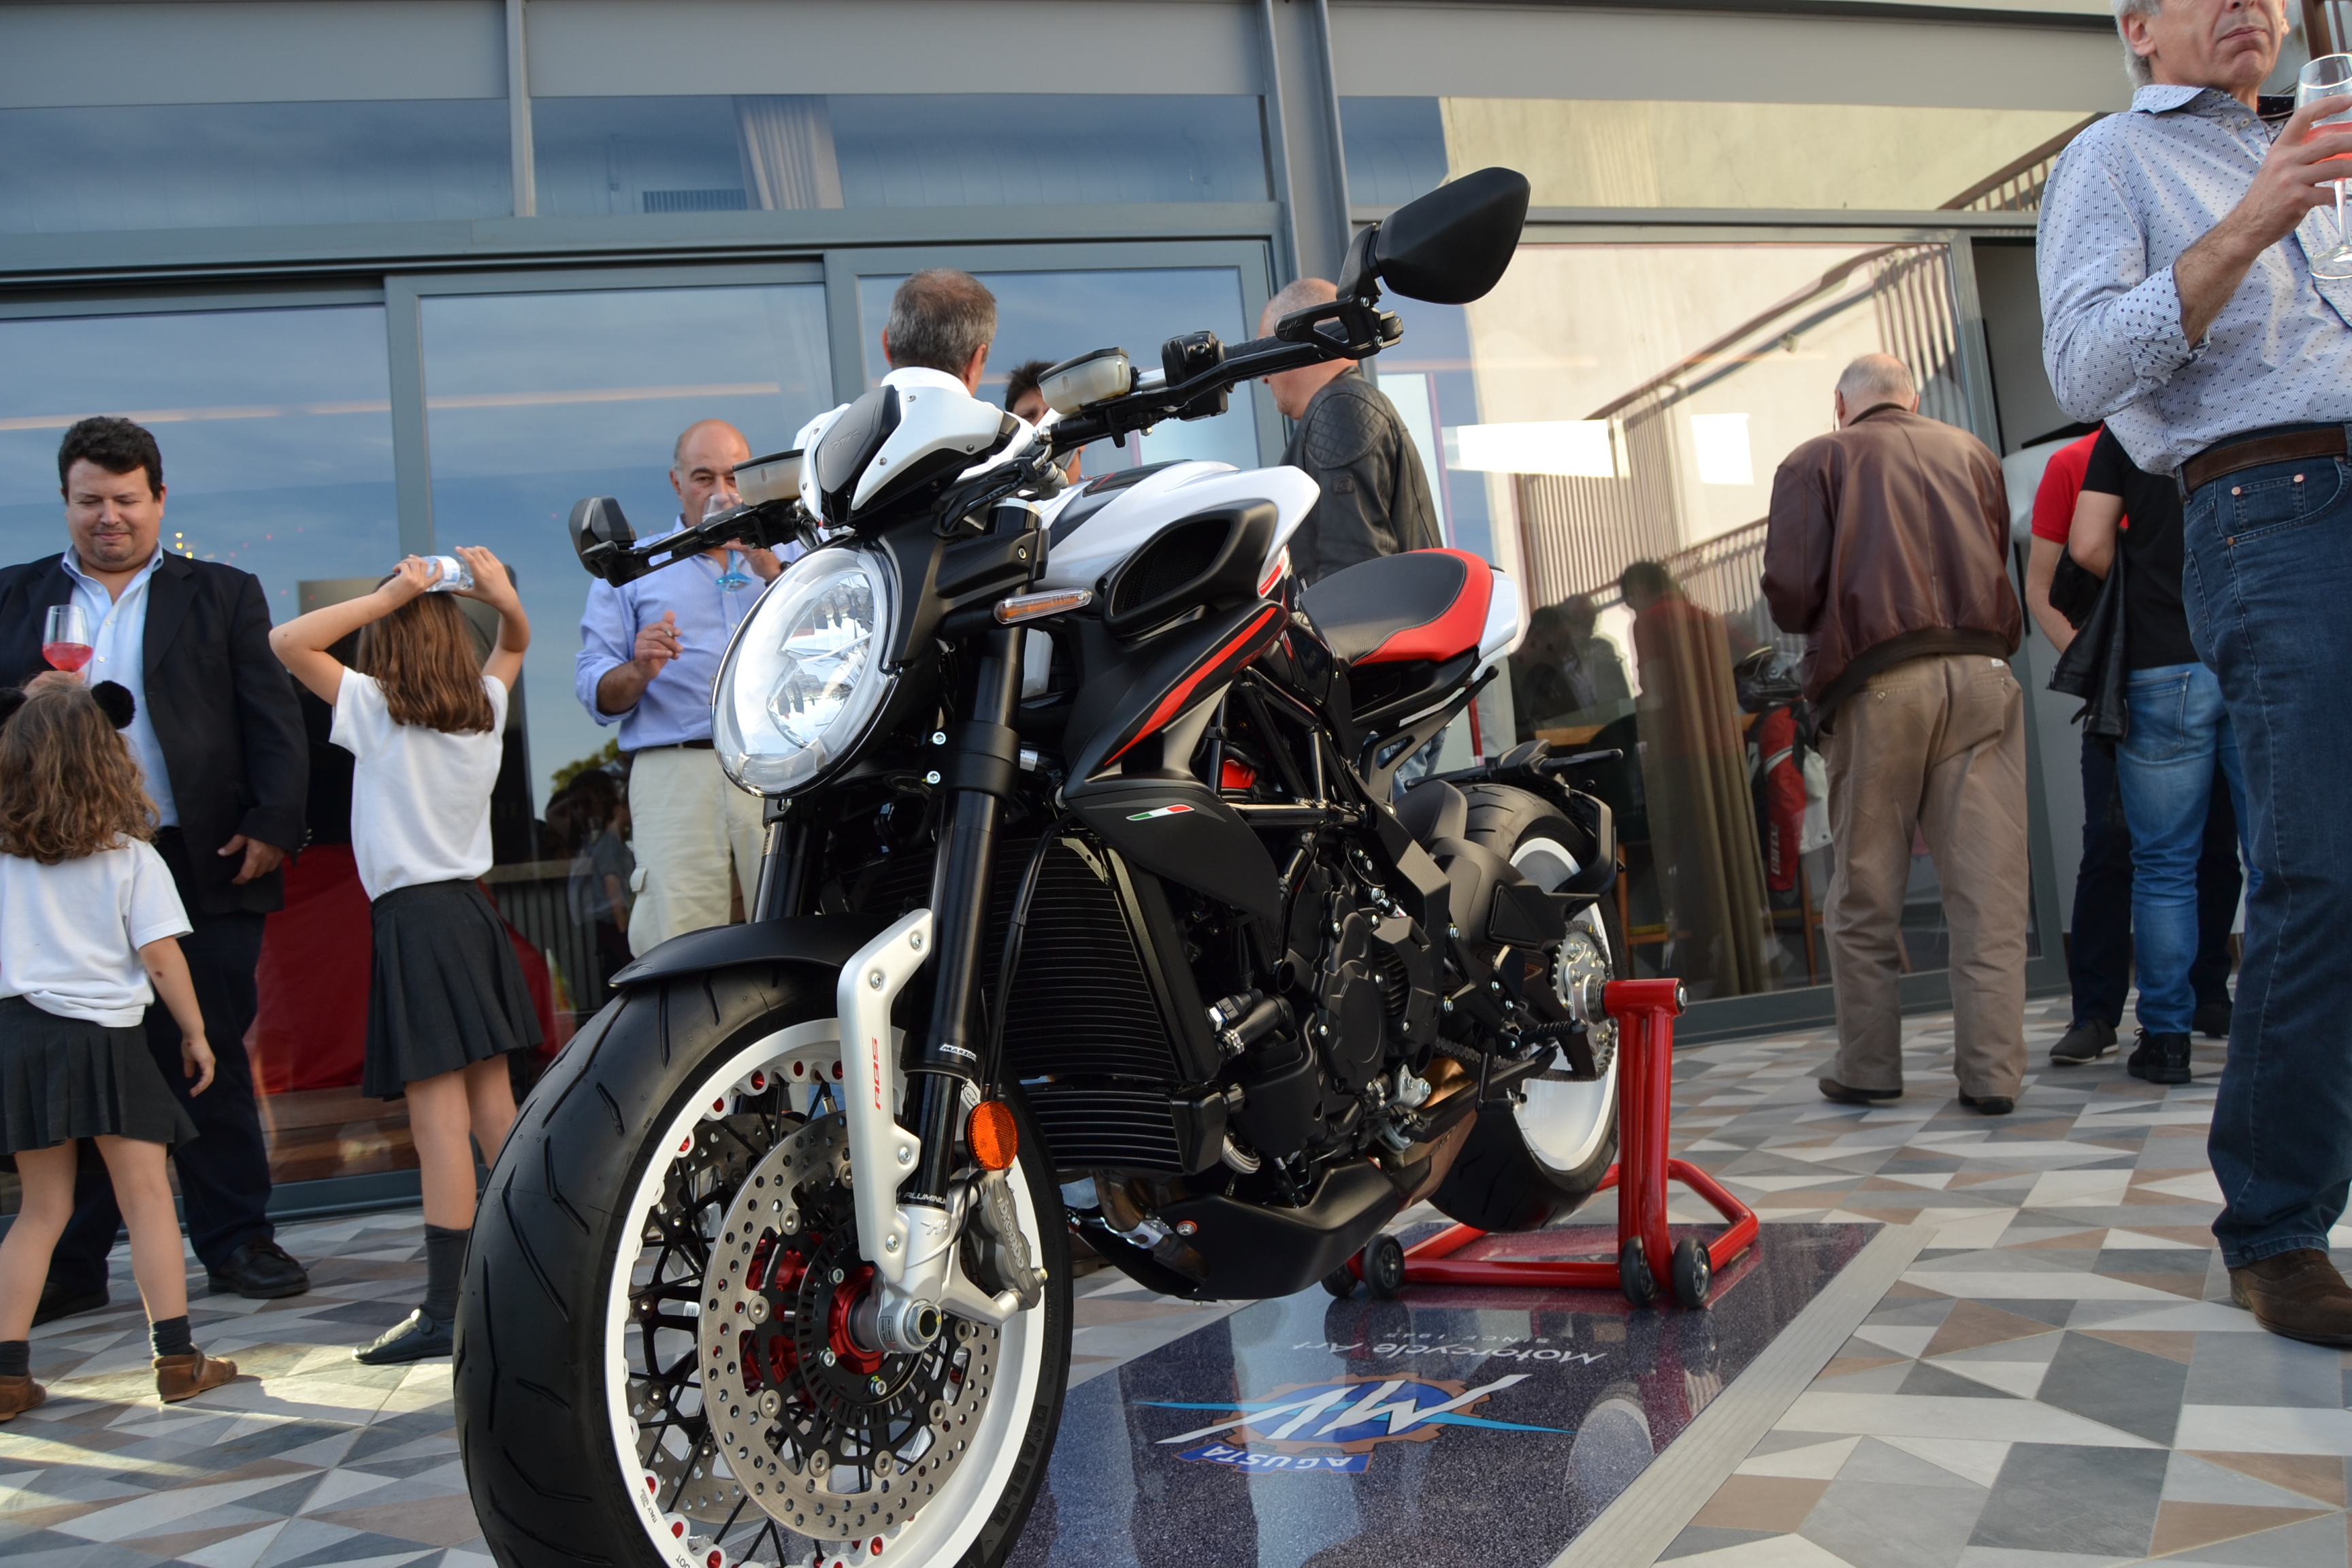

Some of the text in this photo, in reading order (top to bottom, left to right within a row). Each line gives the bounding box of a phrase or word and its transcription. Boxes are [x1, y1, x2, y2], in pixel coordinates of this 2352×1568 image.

[872, 1037, 881, 1111] ABS
[998, 1199, 1025, 1269] brembo
[1292, 1341, 1608, 1365] Motorcycle Art
[1462, 1335, 1550, 1344] SINCE
[1156, 1373, 1533, 1444] MV
[994, 1403, 1049, 1526] DIABLO
[1200, 1446, 1352, 1471] AGUSTA
[647, 1507, 657, 1524] ITALY
